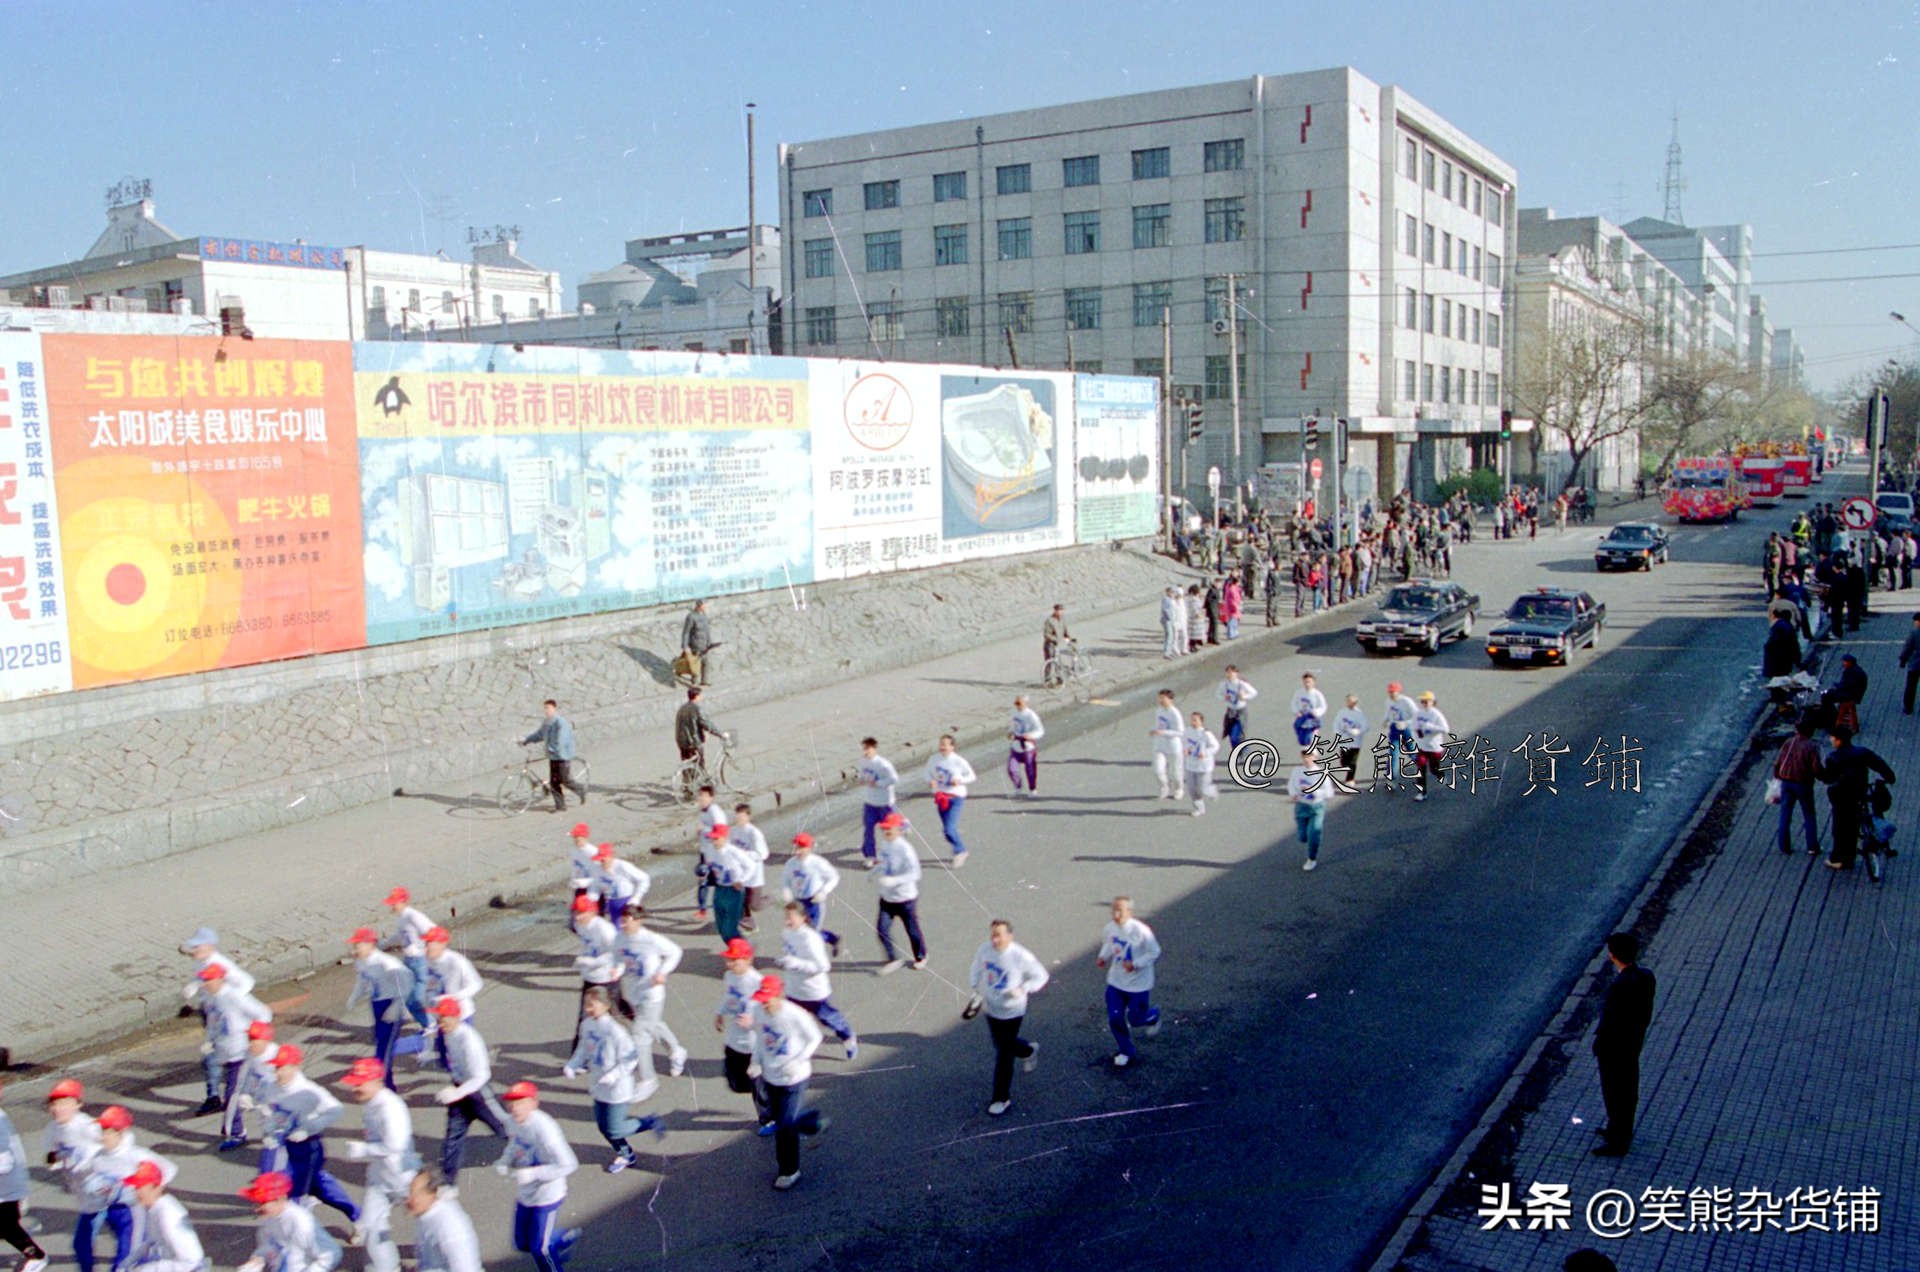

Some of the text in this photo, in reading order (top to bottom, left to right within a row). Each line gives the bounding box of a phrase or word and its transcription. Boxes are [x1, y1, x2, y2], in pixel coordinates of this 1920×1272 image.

[84, 356, 325, 399] 与您共创辉煌
[16, 361, 46, 479] 降低洗衣成本
[427, 380, 795, 429] 哈尔滨市同利饮食机械有限公司
[88, 407, 328, 448] 太阳城美食娱乐中心
[829, 466, 932, 492] 阿波罗按摩浴缸
[237, 494, 332, 524] 肥牛火锅
[31, 502, 58, 618] 提高洗涤效果
